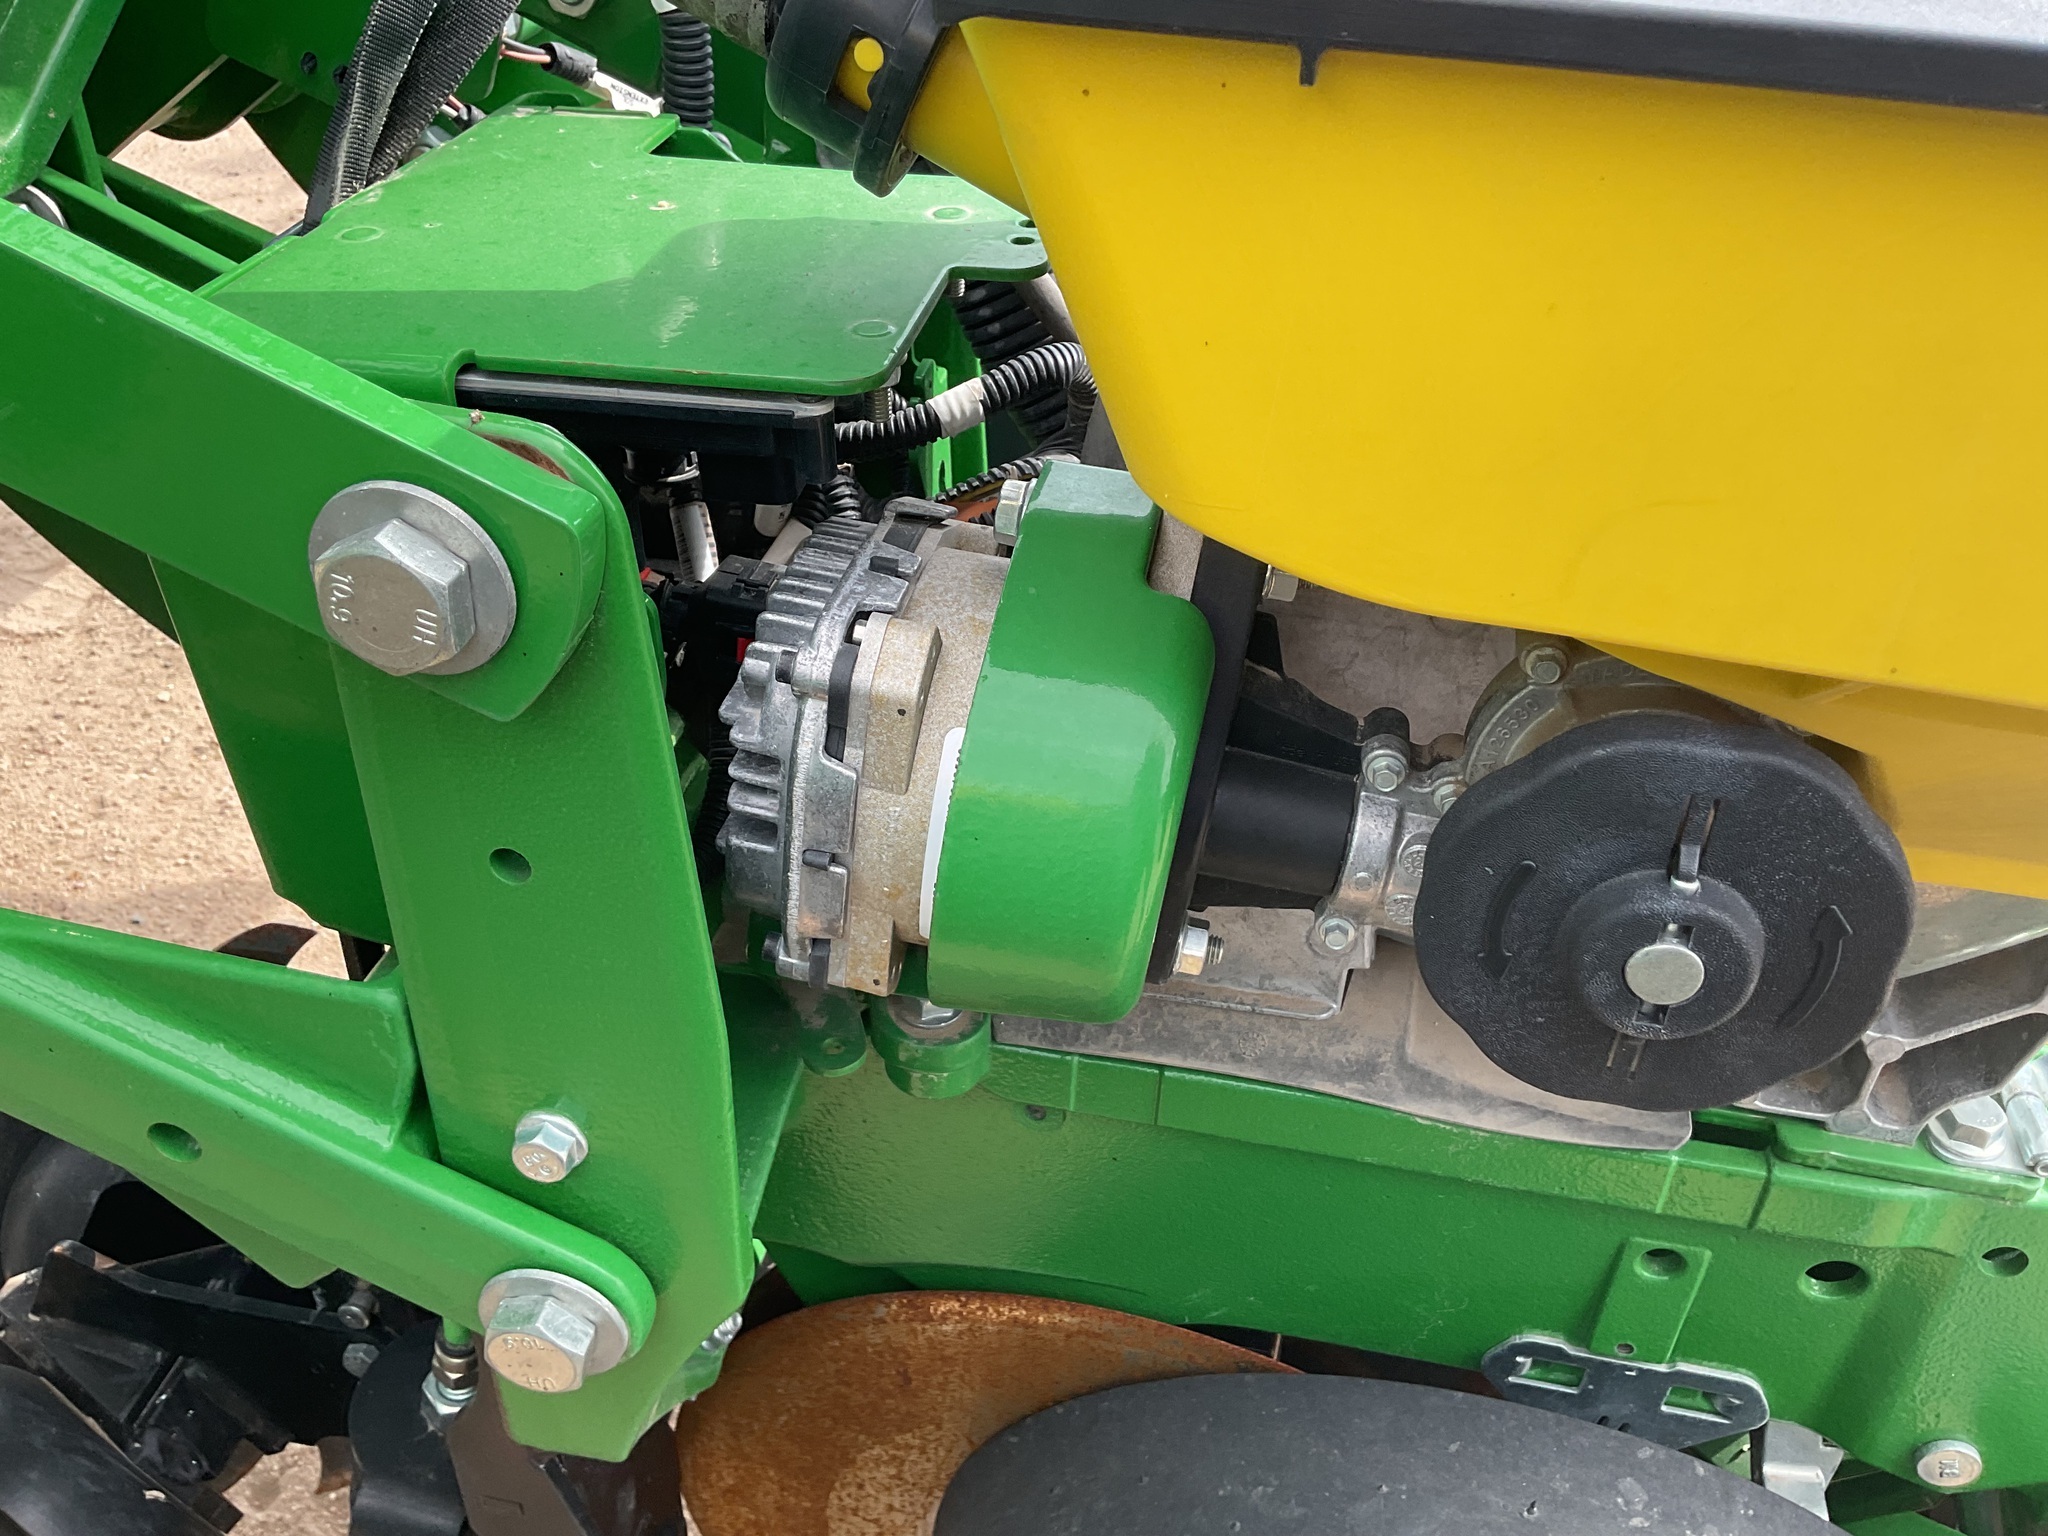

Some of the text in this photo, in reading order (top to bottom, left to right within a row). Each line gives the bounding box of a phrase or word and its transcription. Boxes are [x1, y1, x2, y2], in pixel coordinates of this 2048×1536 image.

[611, 83, 649, 105] EXTENSION
[329, 573, 355, 623] 10.9
[1477, 698, 1539, 773] A126530
